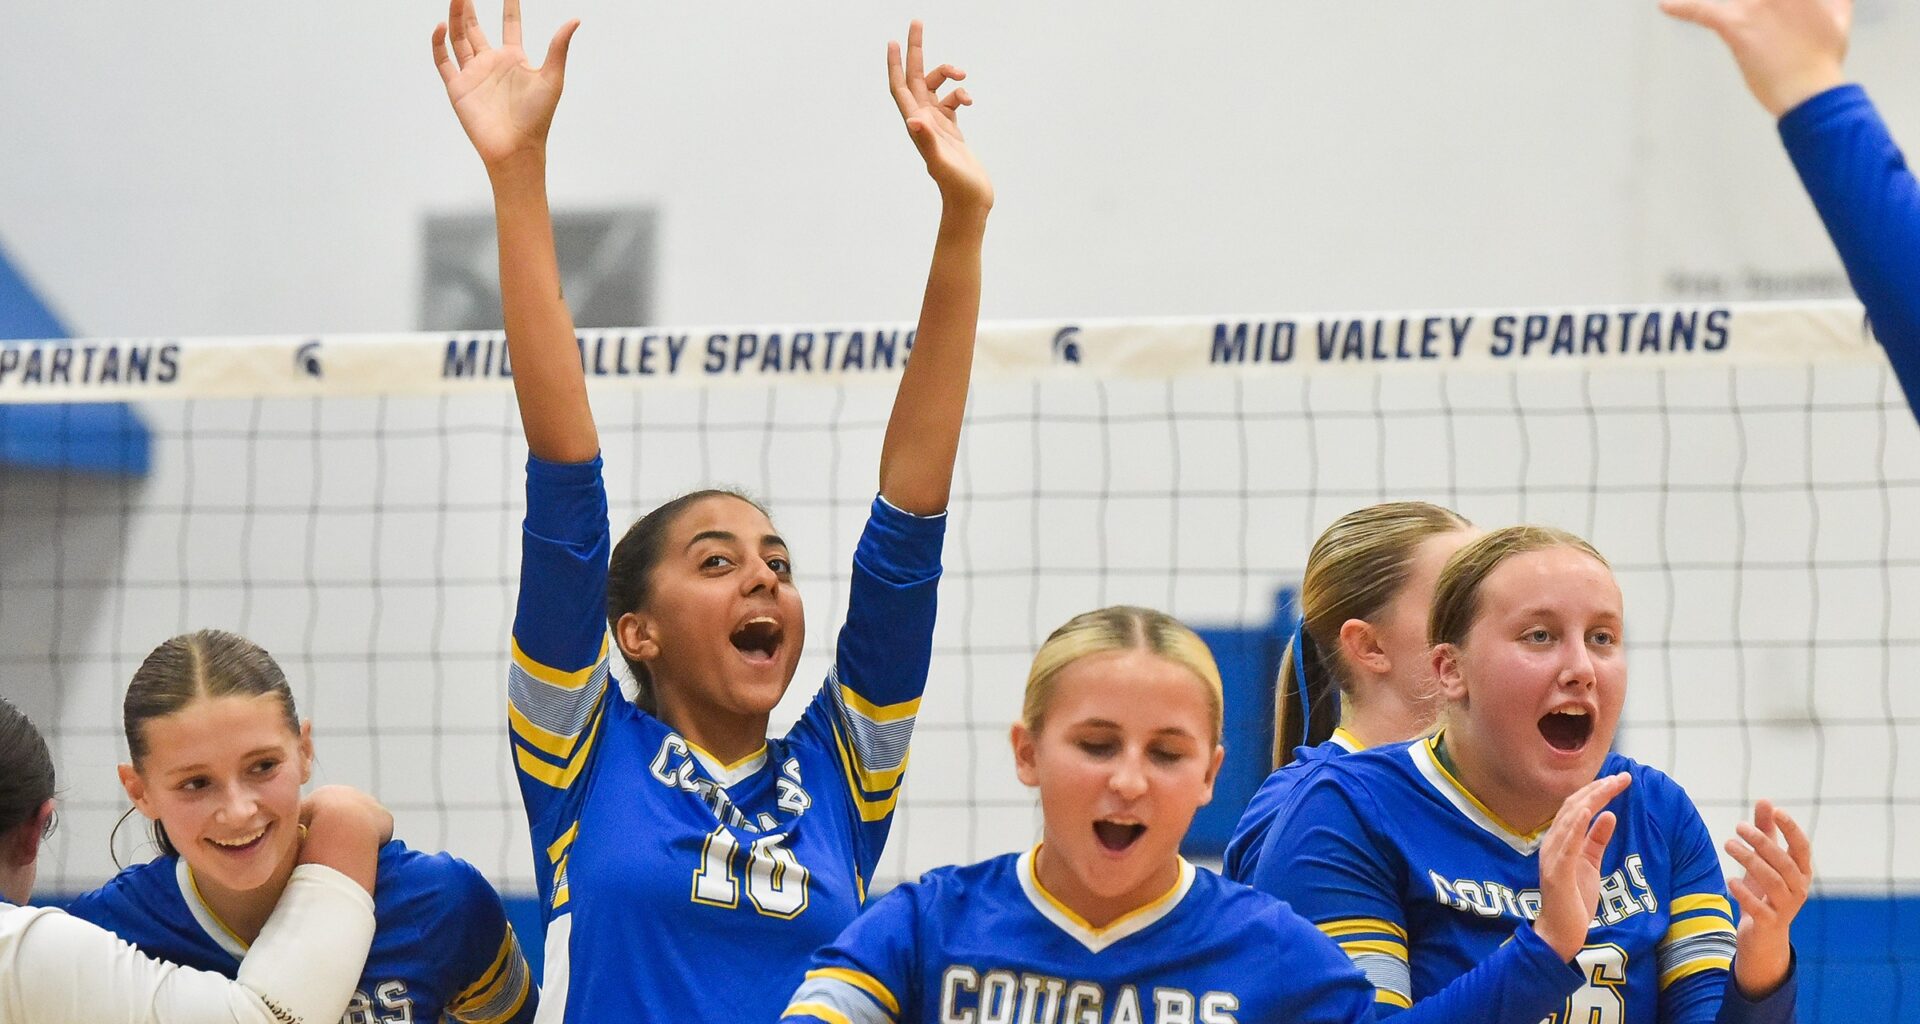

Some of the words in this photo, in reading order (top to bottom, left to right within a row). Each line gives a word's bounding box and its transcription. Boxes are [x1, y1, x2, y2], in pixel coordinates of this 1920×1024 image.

[0, 344, 179, 384] PARTANS
[577, 334, 688, 375] LLEY
[1211, 322, 1297, 363] MID
[1316, 316, 1474, 360] VALLEY
[1490, 309, 1731, 357] SPARTANS
[690, 823, 810, 920] 10
[1428, 853, 1658, 928] COUGRS
[940, 963, 1240, 1024] COUGARS
